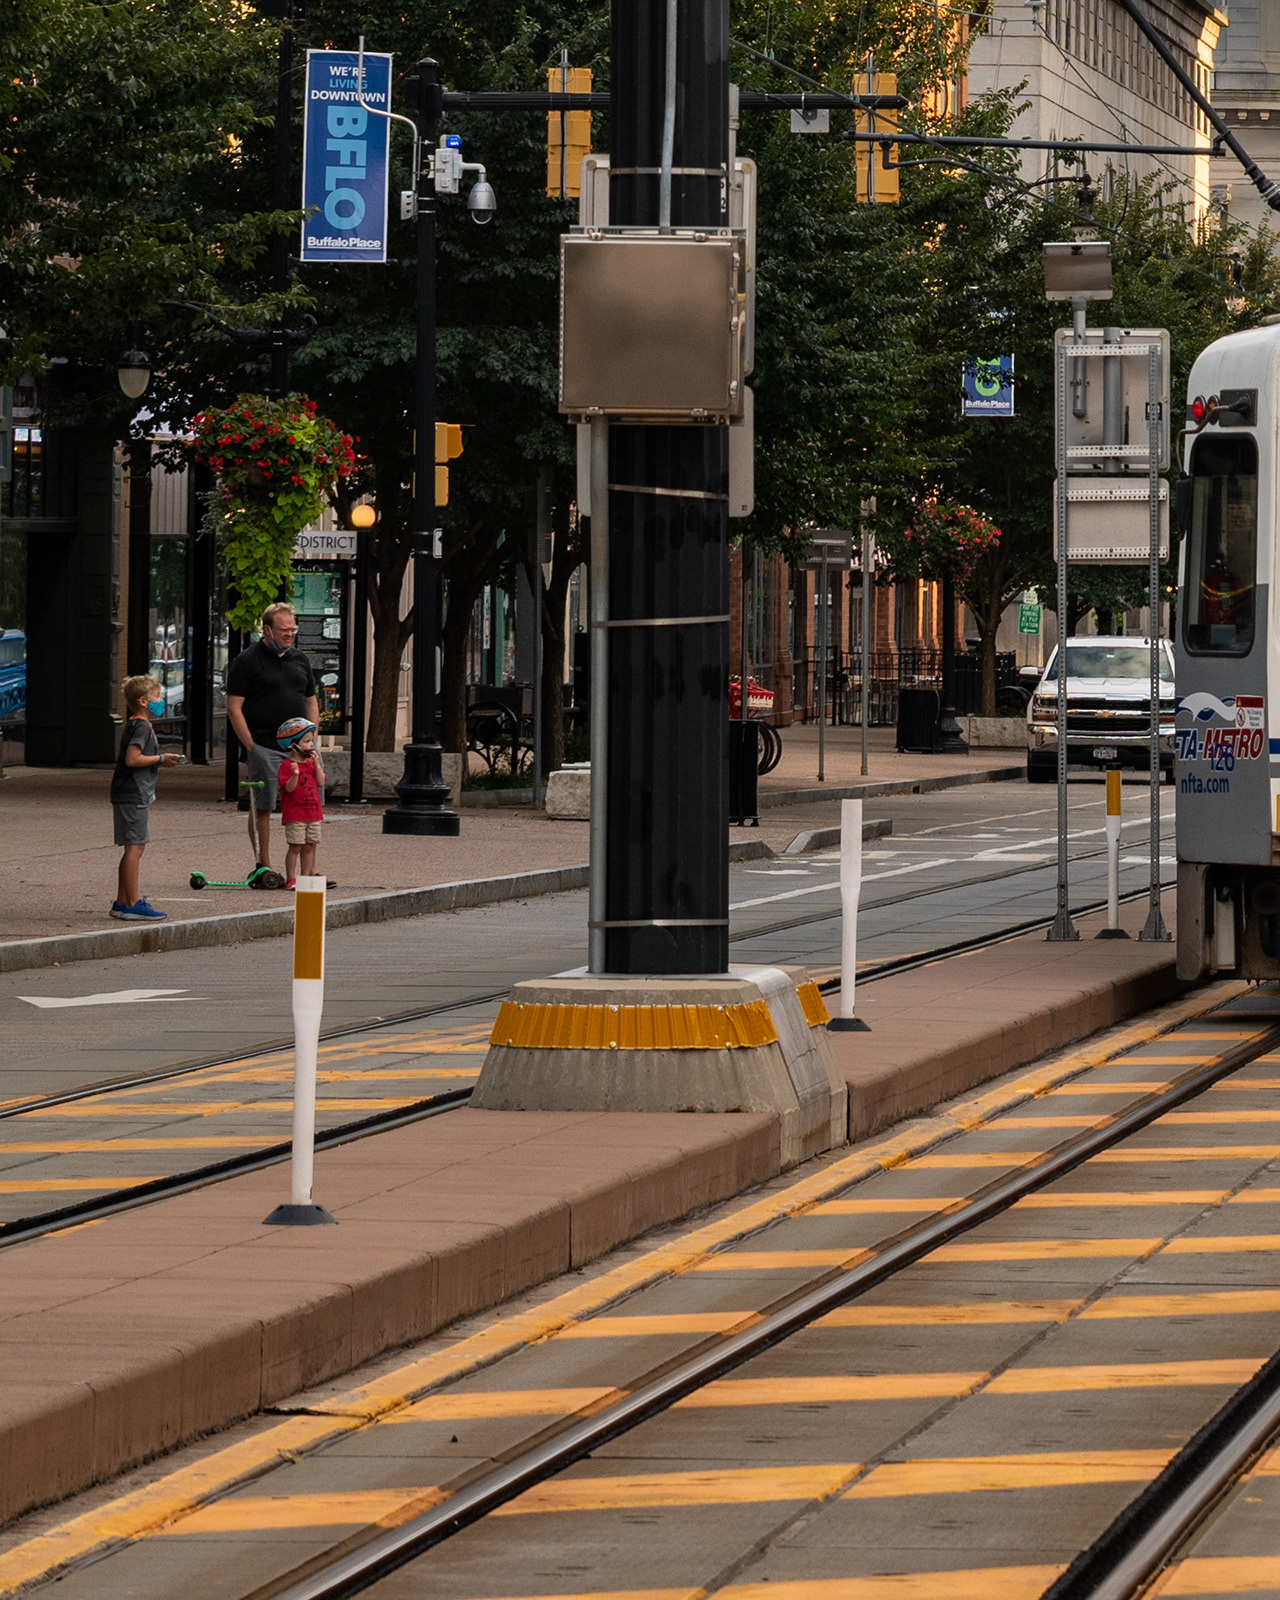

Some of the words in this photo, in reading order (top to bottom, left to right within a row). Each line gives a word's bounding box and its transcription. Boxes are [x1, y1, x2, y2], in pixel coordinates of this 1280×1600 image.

[329, 66, 367, 77] WE'RE
[329, 78, 368, 90] LIVING
[311, 90, 386, 103] DOWNTOWN
[324, 105, 368, 230] BFLO
[300, 535, 355, 549] DISTRICT
[1210, 743, 1235, 773] 126
[1181, 772, 1229, 794] nfta.com
